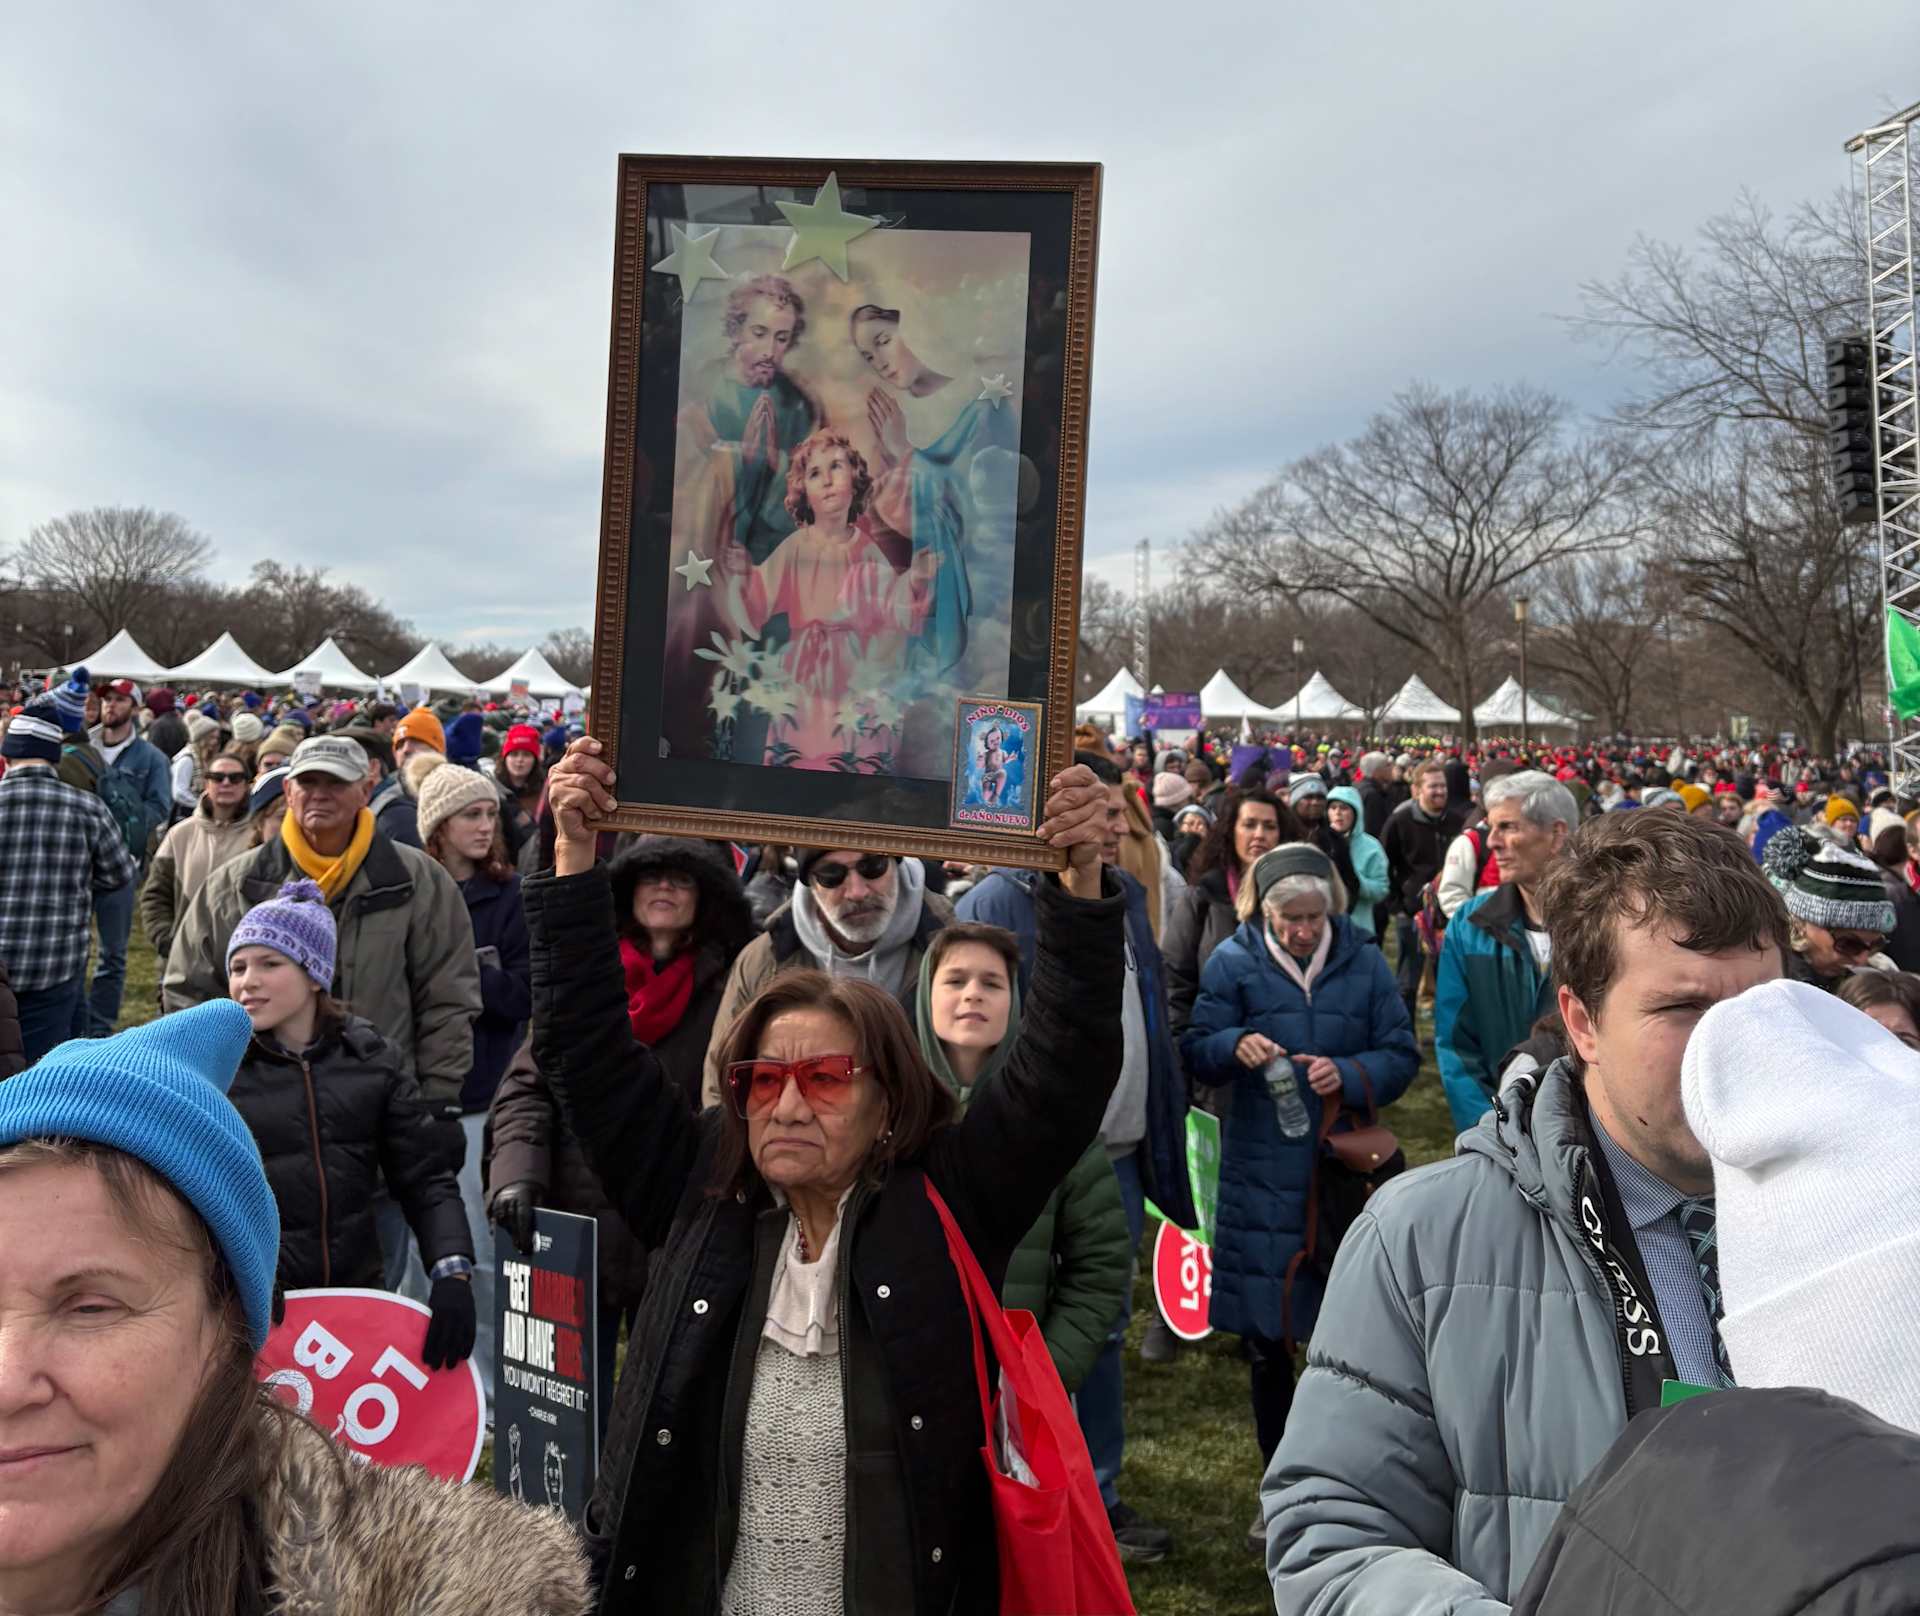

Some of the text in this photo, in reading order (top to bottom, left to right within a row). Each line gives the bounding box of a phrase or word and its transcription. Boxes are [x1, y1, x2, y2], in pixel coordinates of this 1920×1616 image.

[1003, 706, 1030, 732] DIOS
[959, 808, 1030, 826] de AÑO NUEVO
[503, 1310, 526, 1362] AND
[526, 1316, 555, 1373] HAVE
[343, 1345, 430, 1464] LO
[503, 1363, 520, 1388] YOU
[546, 1378, 576, 1408] REGRET
